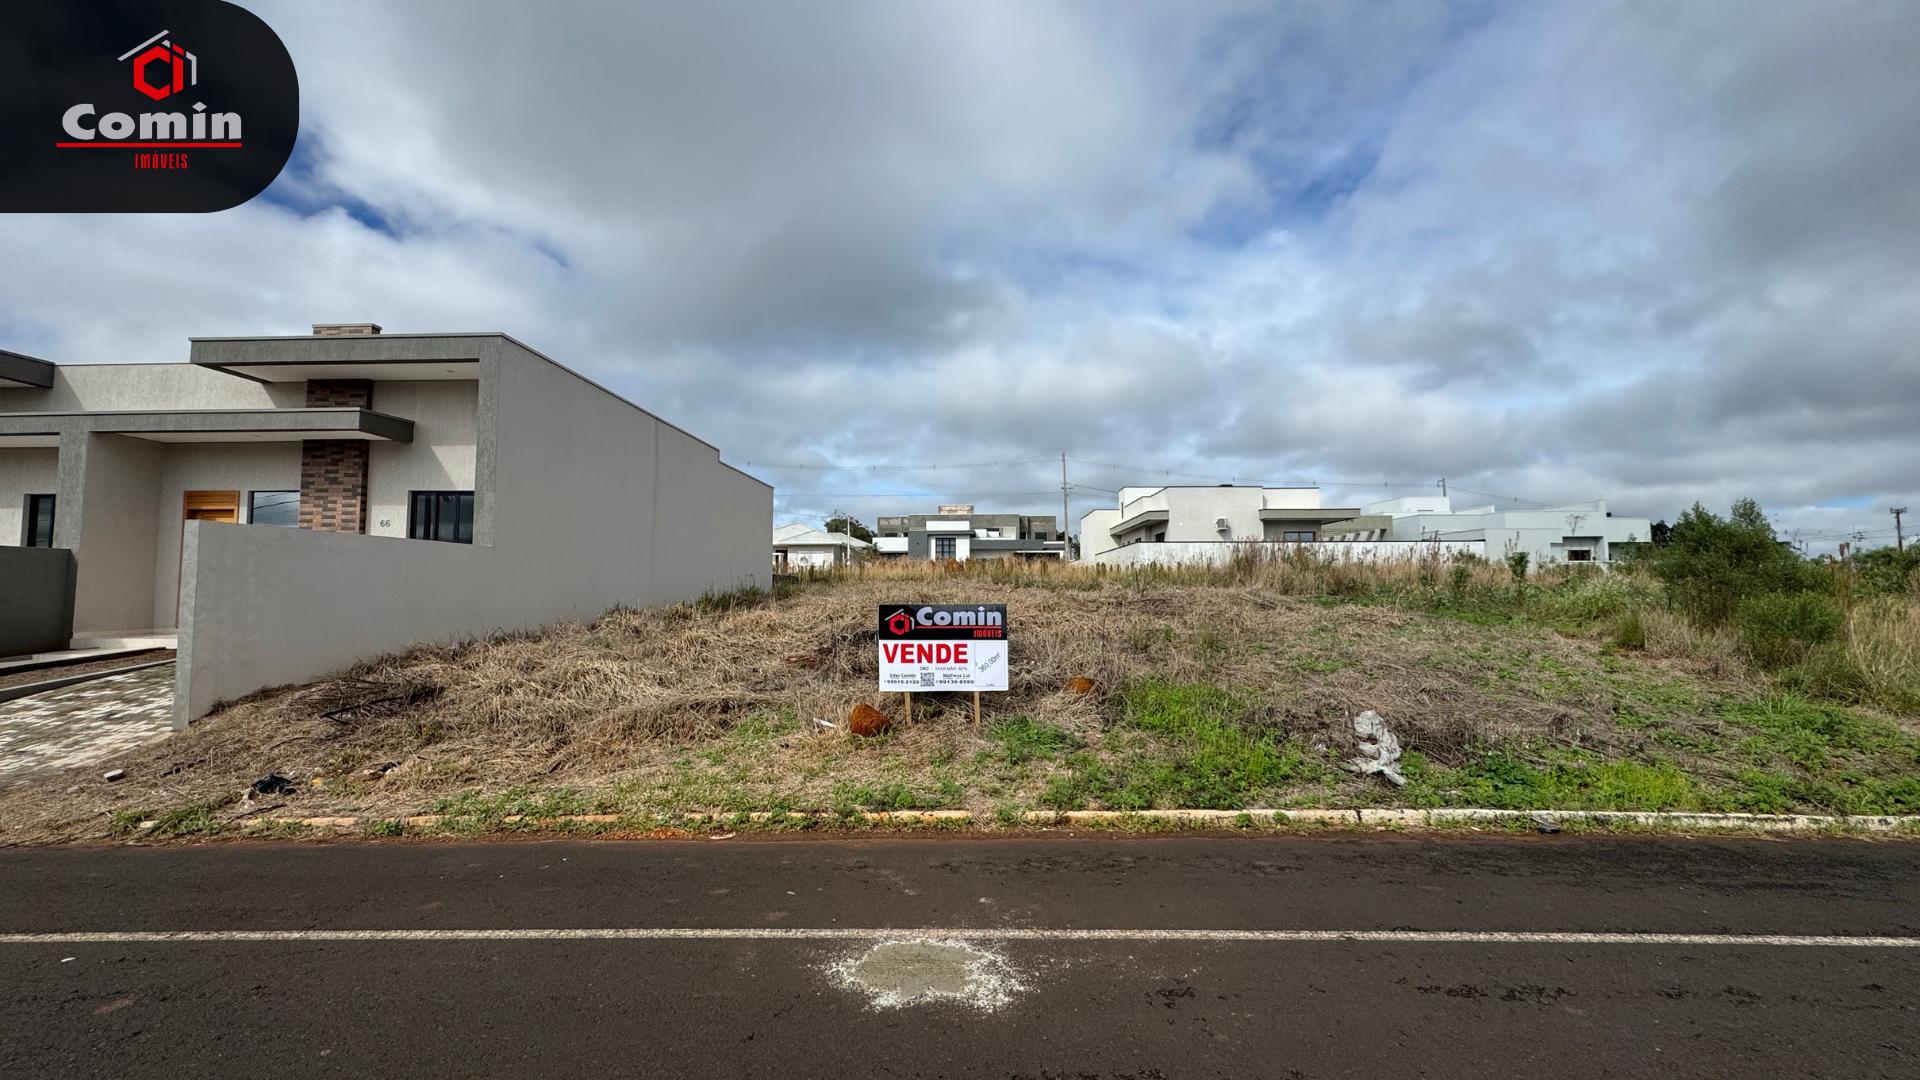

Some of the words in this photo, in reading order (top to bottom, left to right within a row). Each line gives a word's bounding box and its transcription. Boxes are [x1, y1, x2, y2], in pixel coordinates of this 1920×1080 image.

[916, 606, 1002, 626] Comin
[973, 629, 1002, 638] IMÓVEIS
[882, 643, 968, 663] VENDE
